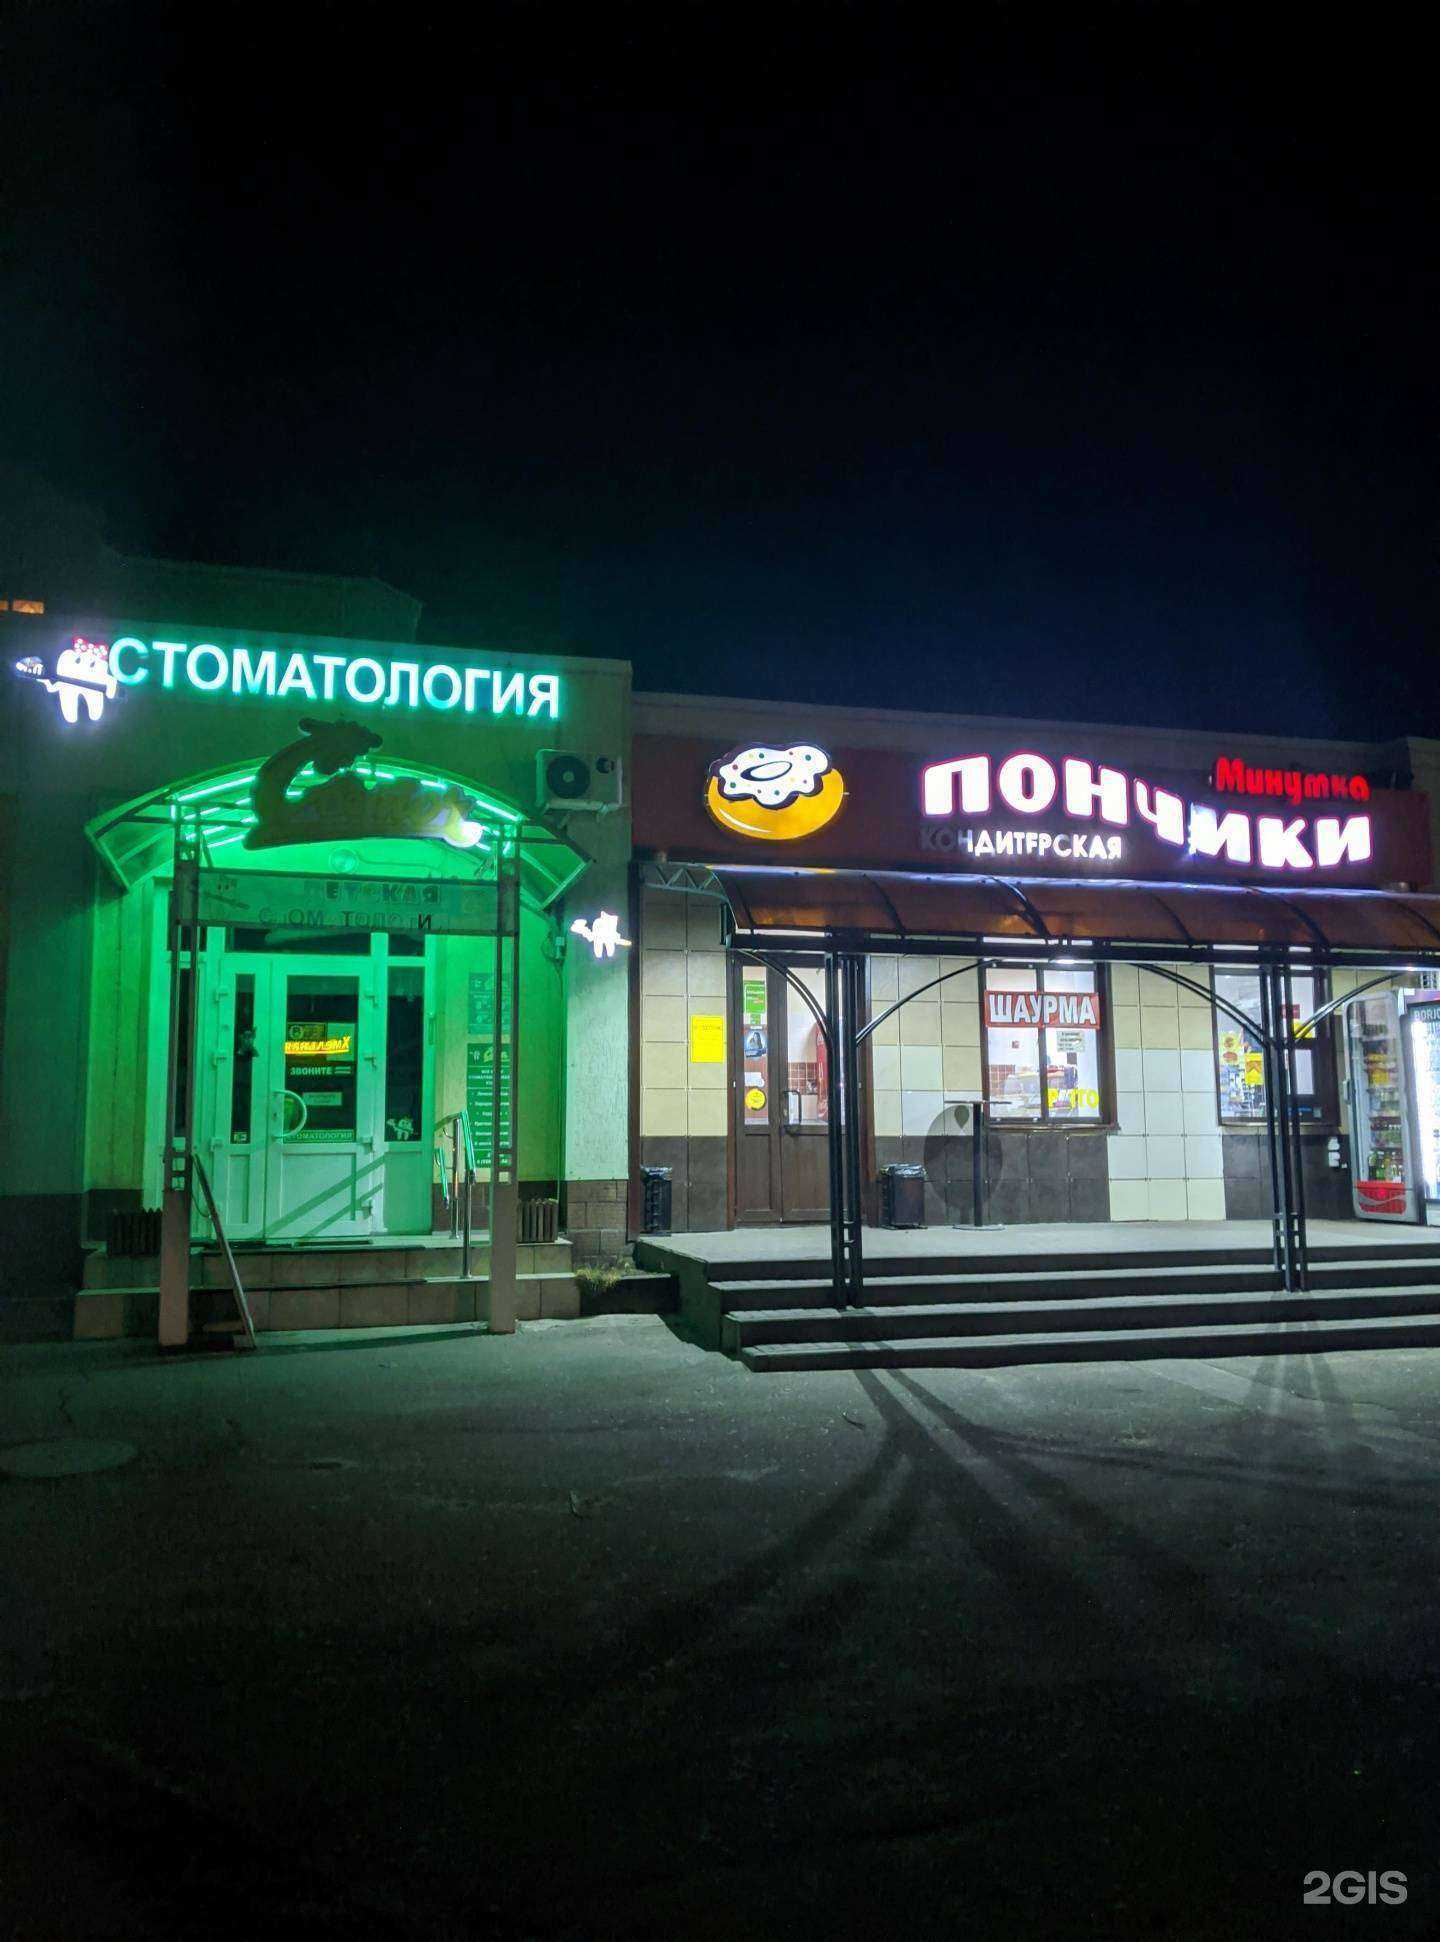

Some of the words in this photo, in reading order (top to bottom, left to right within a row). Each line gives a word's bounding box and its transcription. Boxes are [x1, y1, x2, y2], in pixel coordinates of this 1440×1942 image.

[108, 637, 561, 719] СТОМАТОЛОГИЯ
[922, 753, 1373, 869] ПОНЧИКИ
[989, 994, 1097, 1025] ШАУРМА
